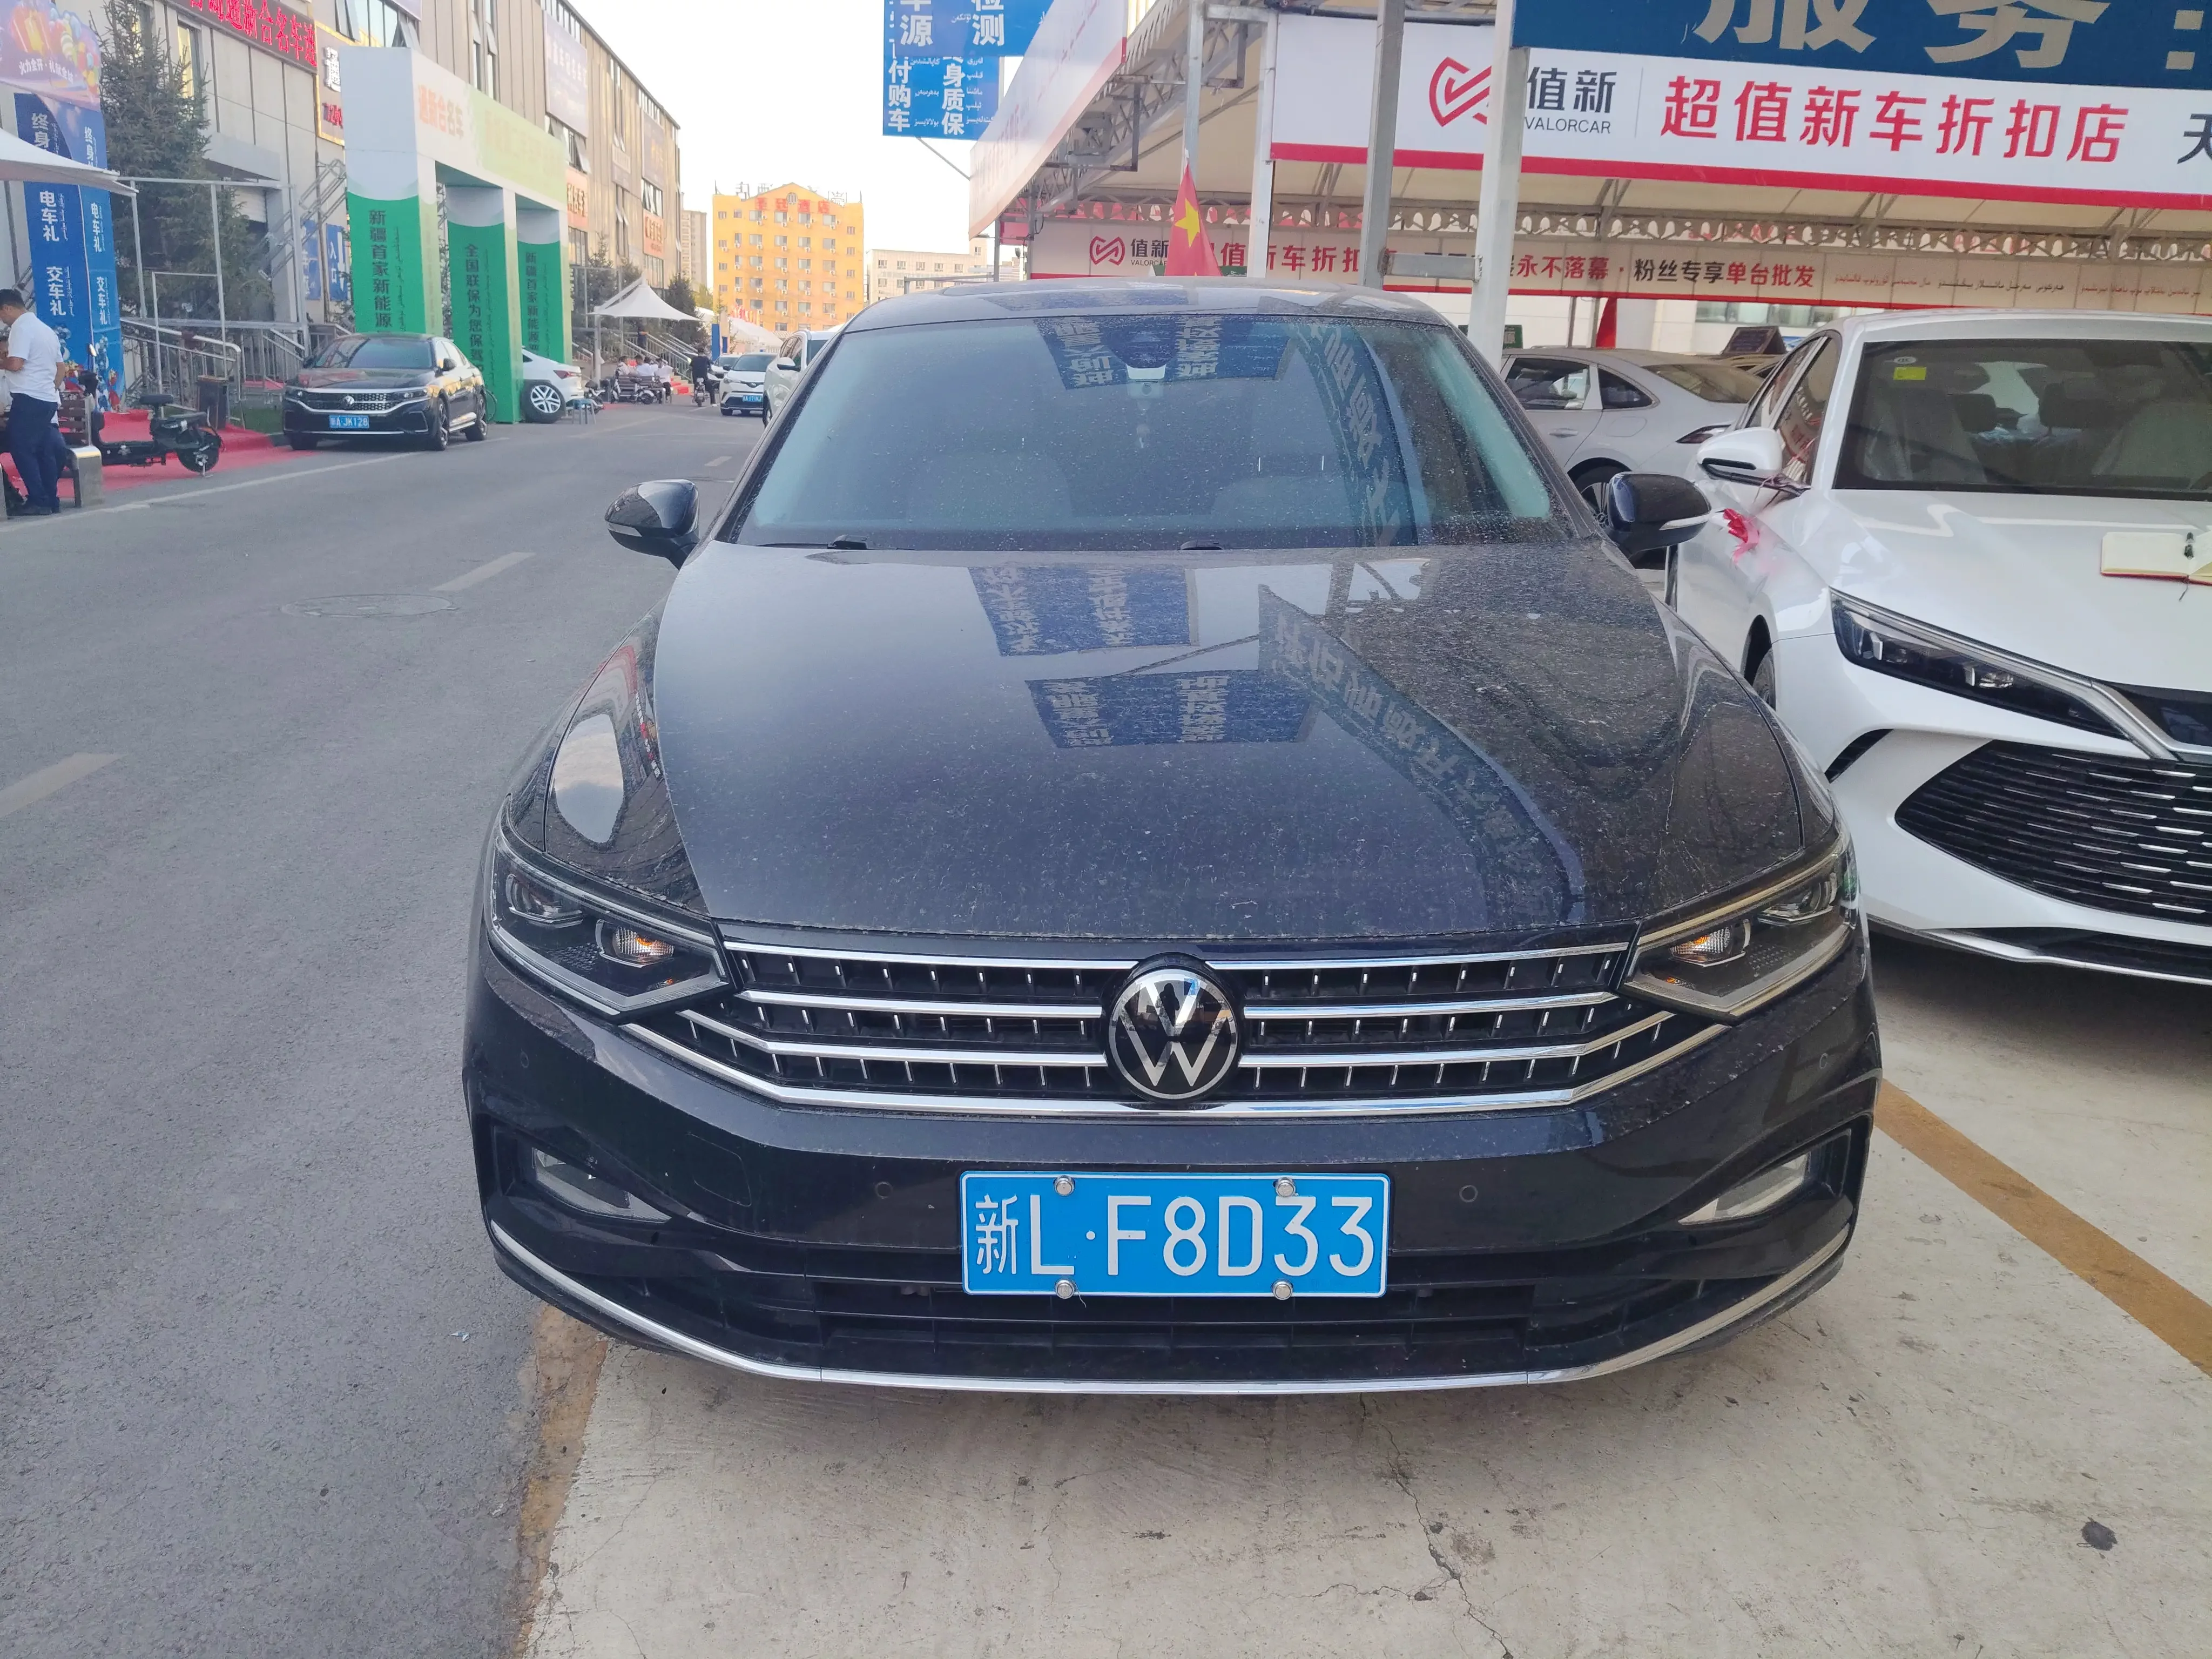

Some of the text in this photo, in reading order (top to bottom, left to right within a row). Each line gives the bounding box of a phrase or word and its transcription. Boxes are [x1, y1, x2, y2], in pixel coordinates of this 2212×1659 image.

[942, 56, 966, 135] 身质保
[1527, 66, 1617, 113] 值新
[1524, 116, 1611, 134] VALORCAR
[1660, 75, 2129, 163] 超值新车折扣店
[39, 191, 59, 241] 电车礼
[91, 202, 102, 252] 电车礼
[46, 266, 66, 316] 交车礼
[369, 210, 392, 328] 新疆首家新能源
[97, 276, 107, 325] 交车礼
[975, 1194, 1374, 1277] 新L·F8D33
